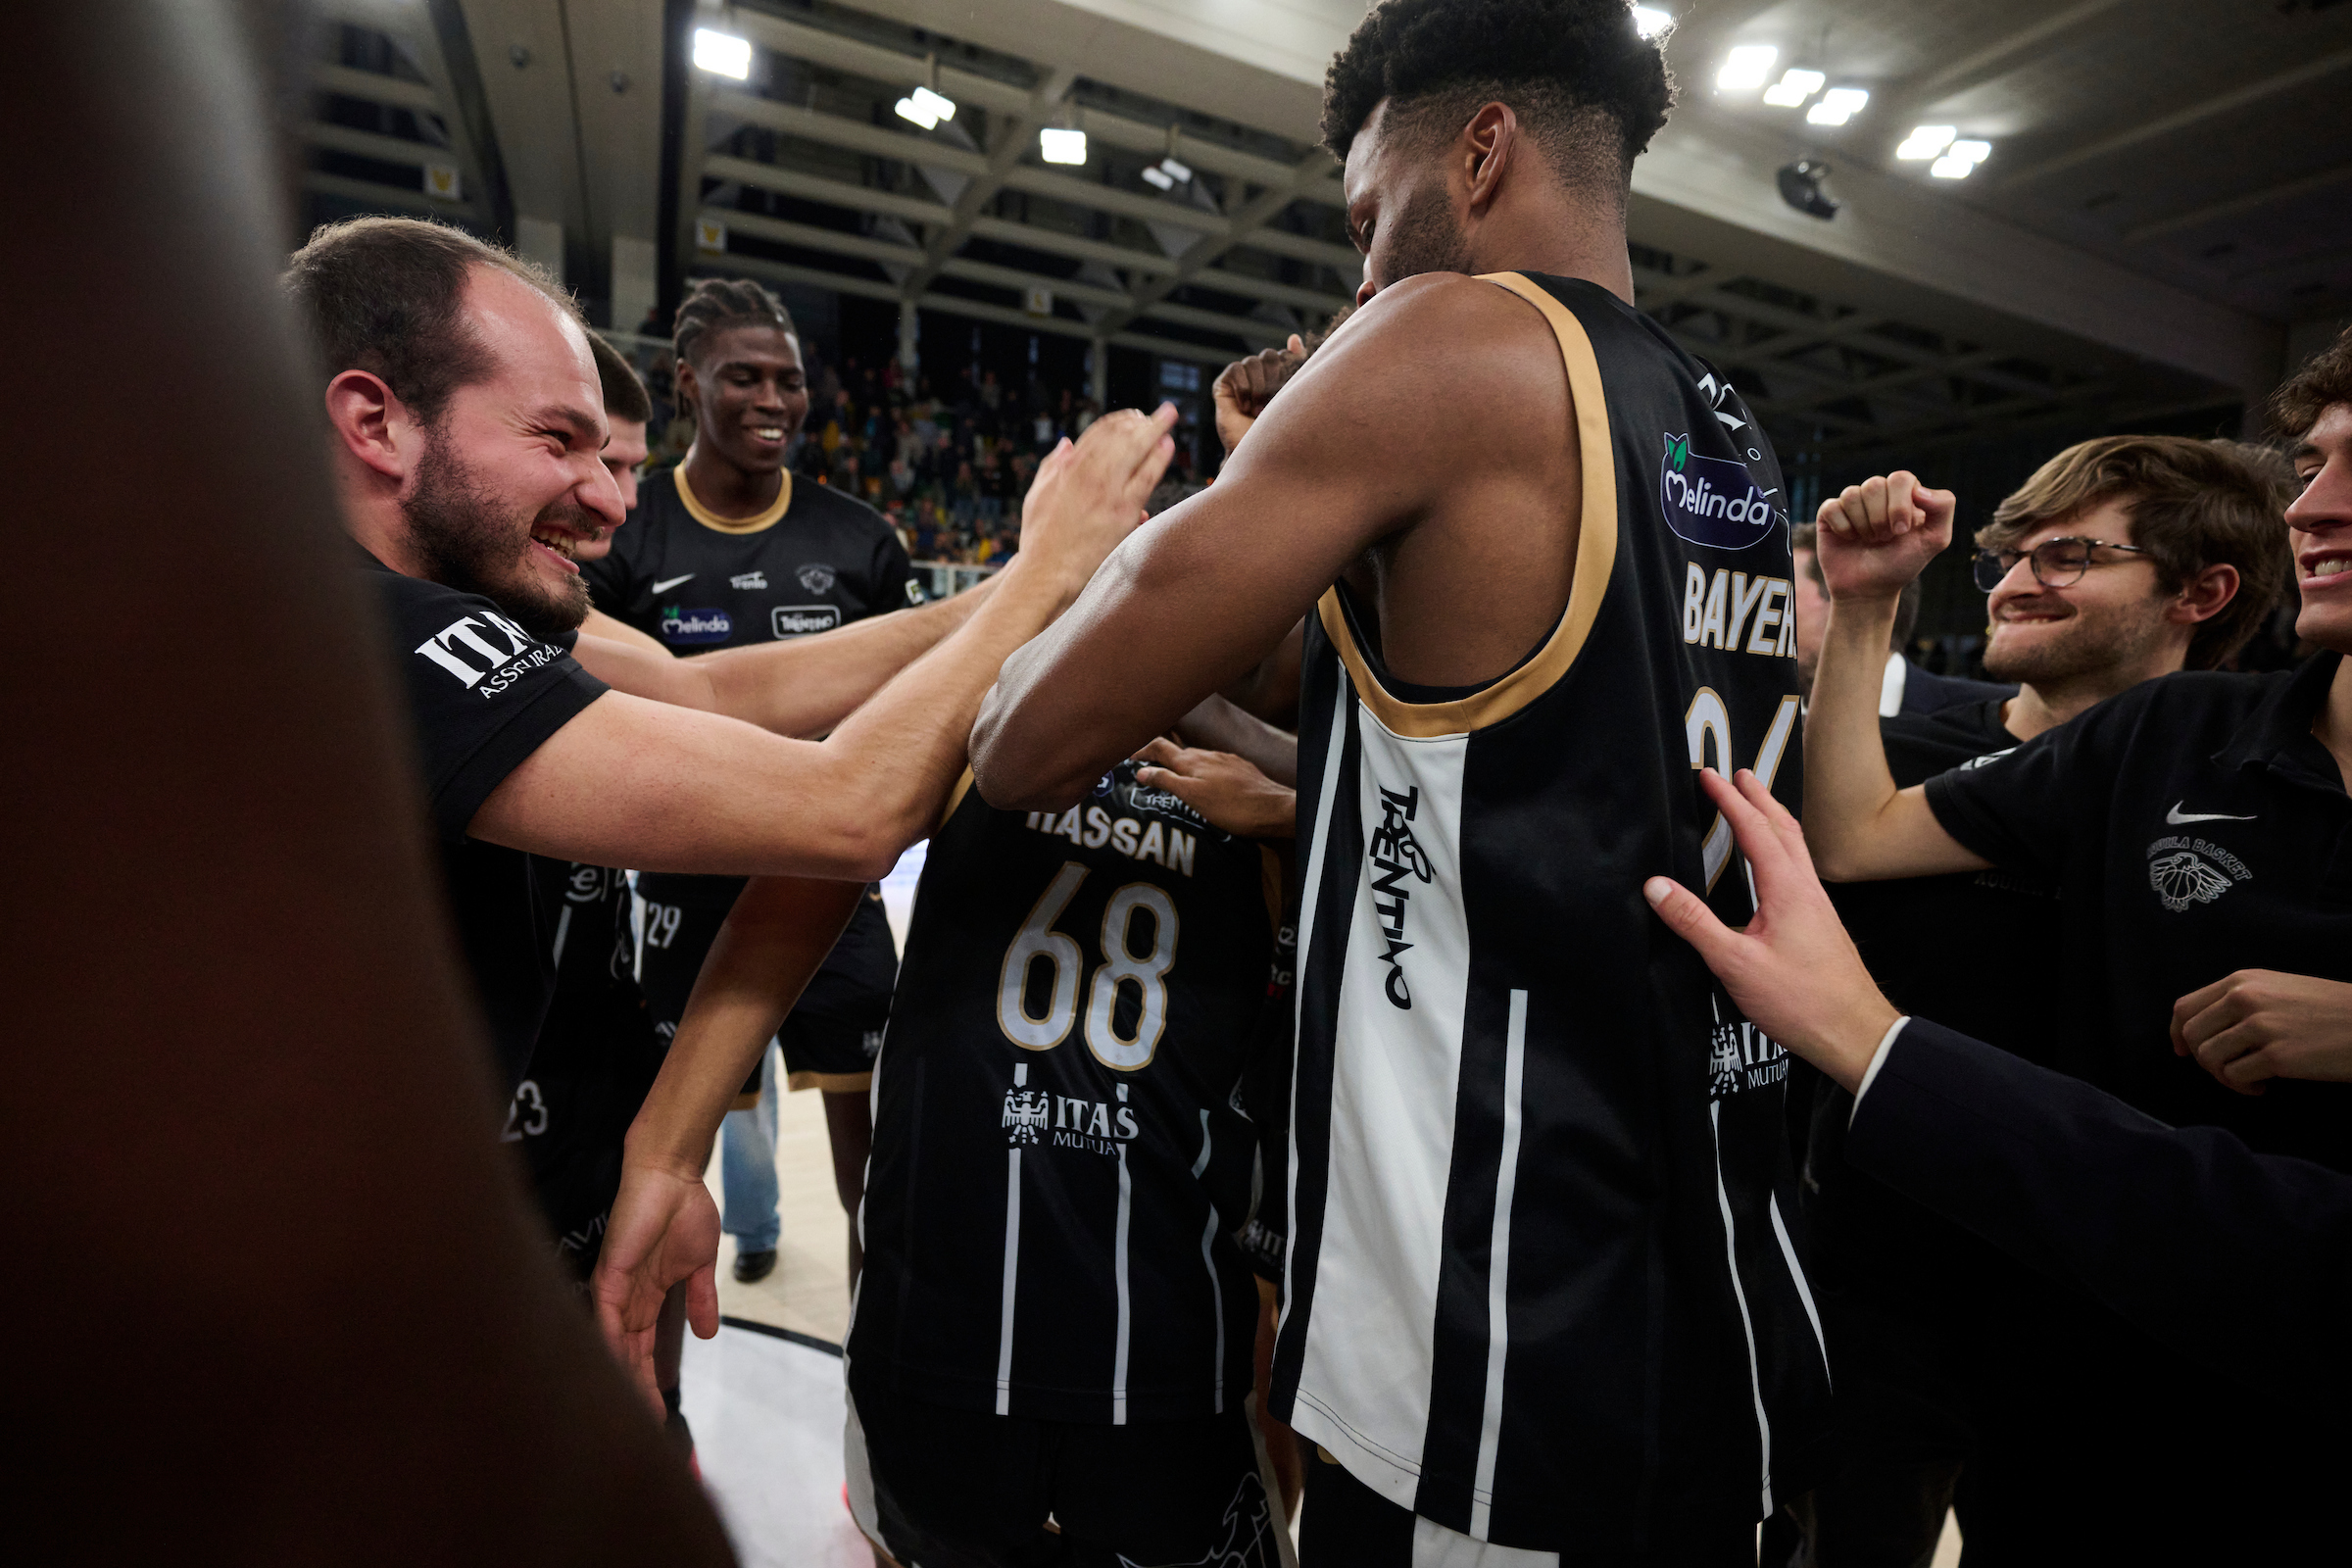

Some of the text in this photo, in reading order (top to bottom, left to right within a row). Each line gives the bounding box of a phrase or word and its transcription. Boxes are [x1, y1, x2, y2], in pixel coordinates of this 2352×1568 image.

[1666, 468, 1771, 527] Melinda
[661, 614, 731, 635] Melinda
[1683, 561, 1797, 660] BAYEH
[414, 611, 535, 690] ITA
[2191, 837, 2254, 882] BASKET
[647, 901, 683, 951] 29
[996, 859, 1181, 1072] 68
[1054, 1094, 1140, 1140] ITAS
[1052, 1130, 1117, 1155] MUTUA
